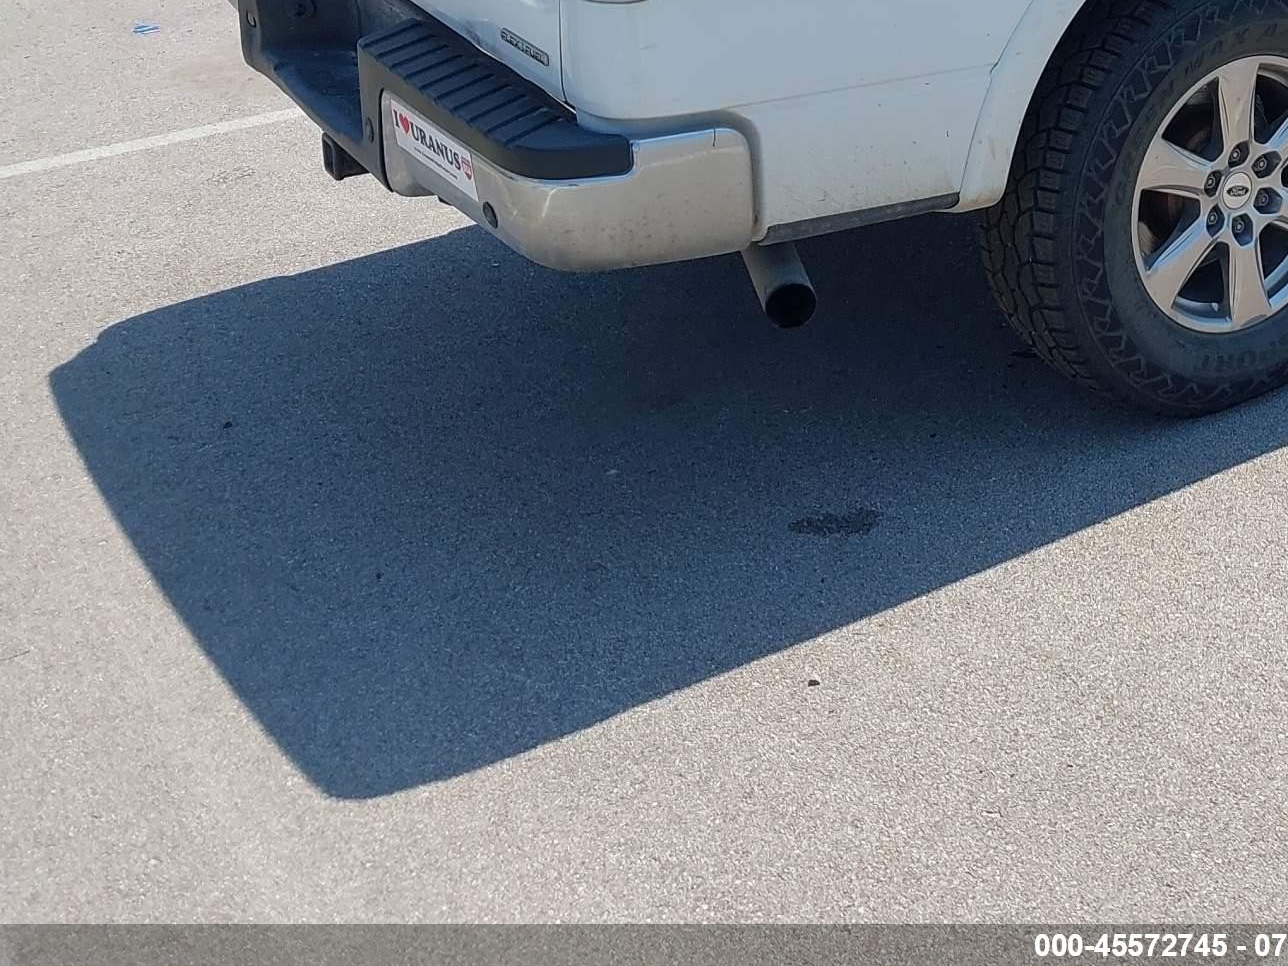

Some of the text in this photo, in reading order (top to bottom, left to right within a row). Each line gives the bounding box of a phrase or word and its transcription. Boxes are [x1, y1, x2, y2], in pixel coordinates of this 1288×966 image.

[392, 108, 401, 129] I
[410, 120, 462, 172] URANUS
[1229, 187, 1248, 197] Ford
